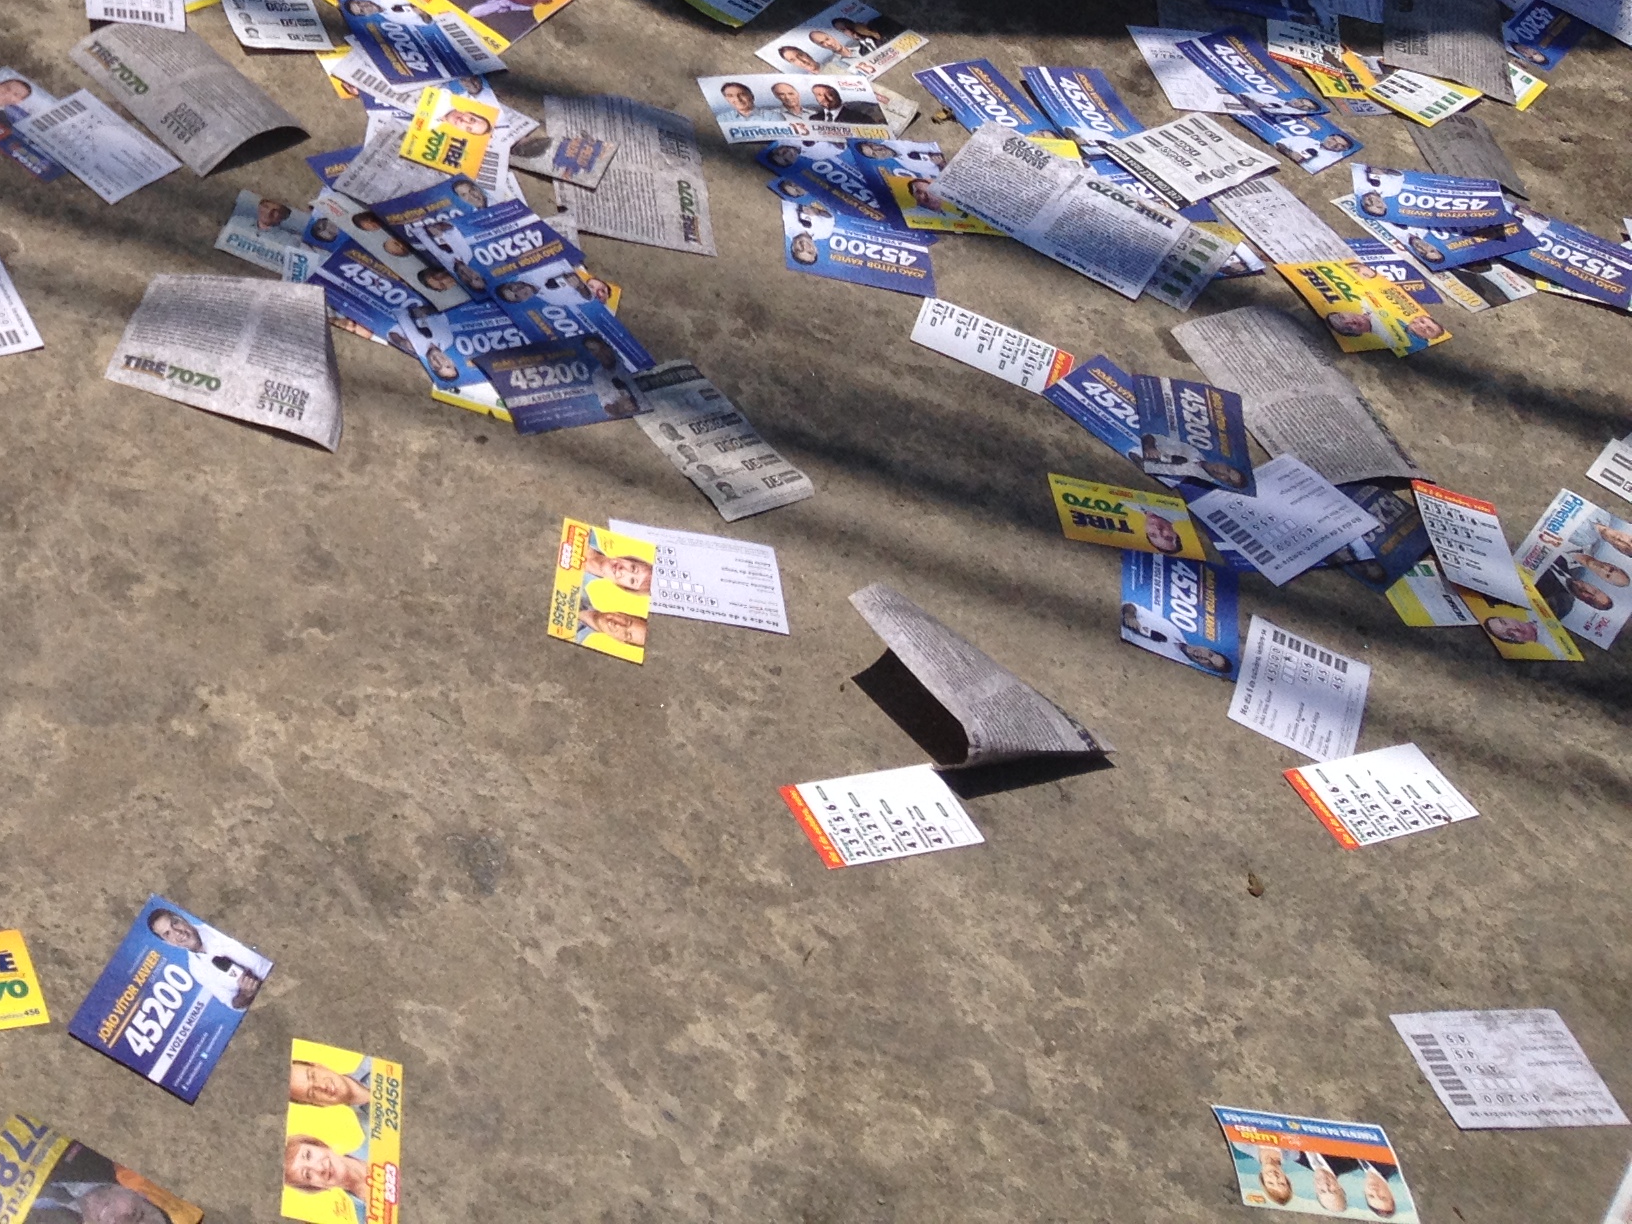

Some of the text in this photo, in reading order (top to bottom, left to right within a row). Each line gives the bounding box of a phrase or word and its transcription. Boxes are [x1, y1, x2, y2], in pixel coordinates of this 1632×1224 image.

[1214, 43, 1279, 96] 45200
[1060, 77, 1114, 132] 45200
[160, 115, 192, 144] 51181
[422, 129, 447, 162] 7070
[811, 159, 881, 211] 45200
[1398, 192, 1489, 211] 45200
[474, 228, 544, 266] 45200
[829, 234, 918, 267] 45200
[1316, 266, 1360, 302] 7070
[264, 380, 309, 399] CLEITON
[510, 361, 590, 390] 45200
[256, 400, 305, 421] 51181
[263, 389, 307, 408] XAVIER
[1179, 388, 1213, 451] 45200
[1062, 493, 1129, 516] 7070
[552, 590, 567, 626] 23456
[1170, 561, 1198, 633] 45200
[125, 964, 194, 1057] 45200
[187, 1001, 206, 1028] MINAS
[384, 1078, 399, 1131] 23456
